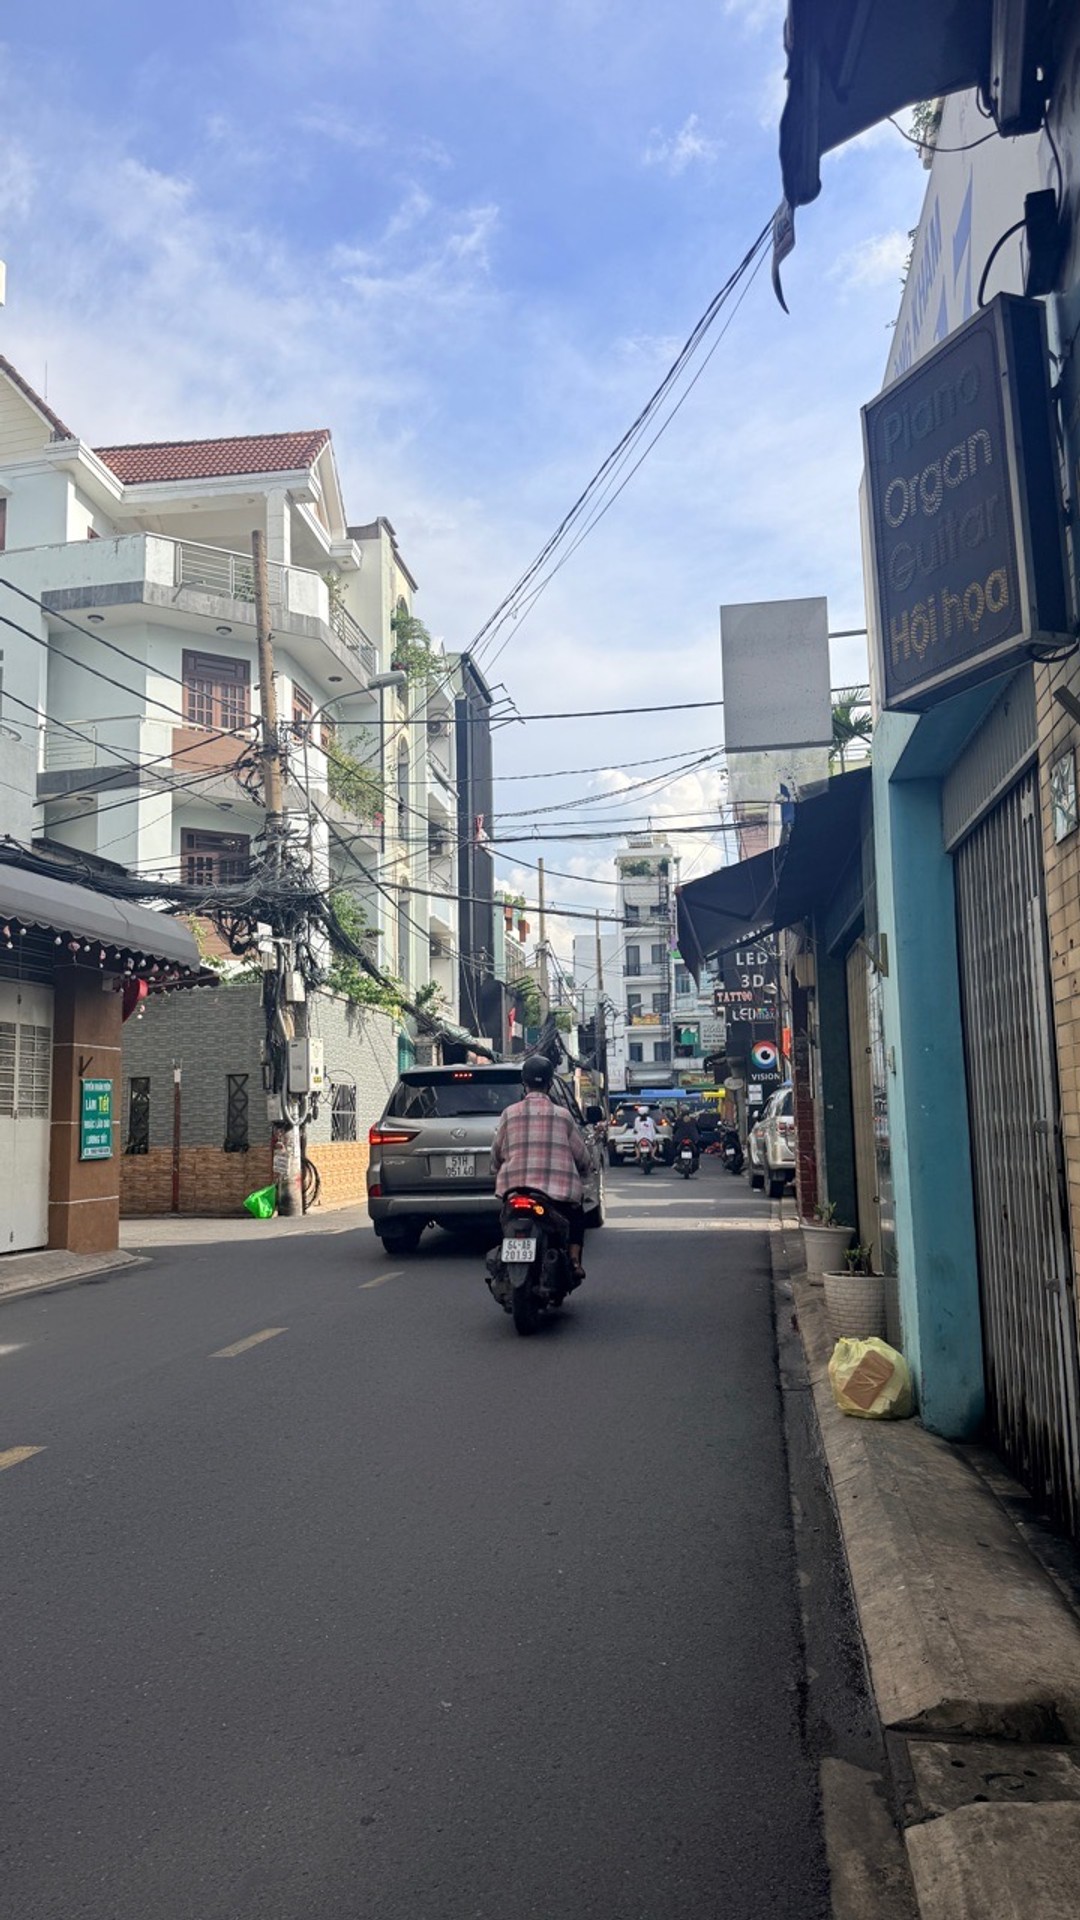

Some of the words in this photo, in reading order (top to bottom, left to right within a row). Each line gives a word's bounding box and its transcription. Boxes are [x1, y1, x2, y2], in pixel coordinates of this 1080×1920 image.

[883, 362, 980, 464] Piano
[884, 428, 993, 528] Organ
[887, 493, 1000, 591] Guitar
[890, 593, 938, 666] Hội
[736, 952, 769, 966] LED
[741, 974, 765, 988] 3D
[716, 991, 753, 1002] TATTOO
[751, 1073, 780, 1081] VISION
[451, 1156, 468, 1166] 51H
